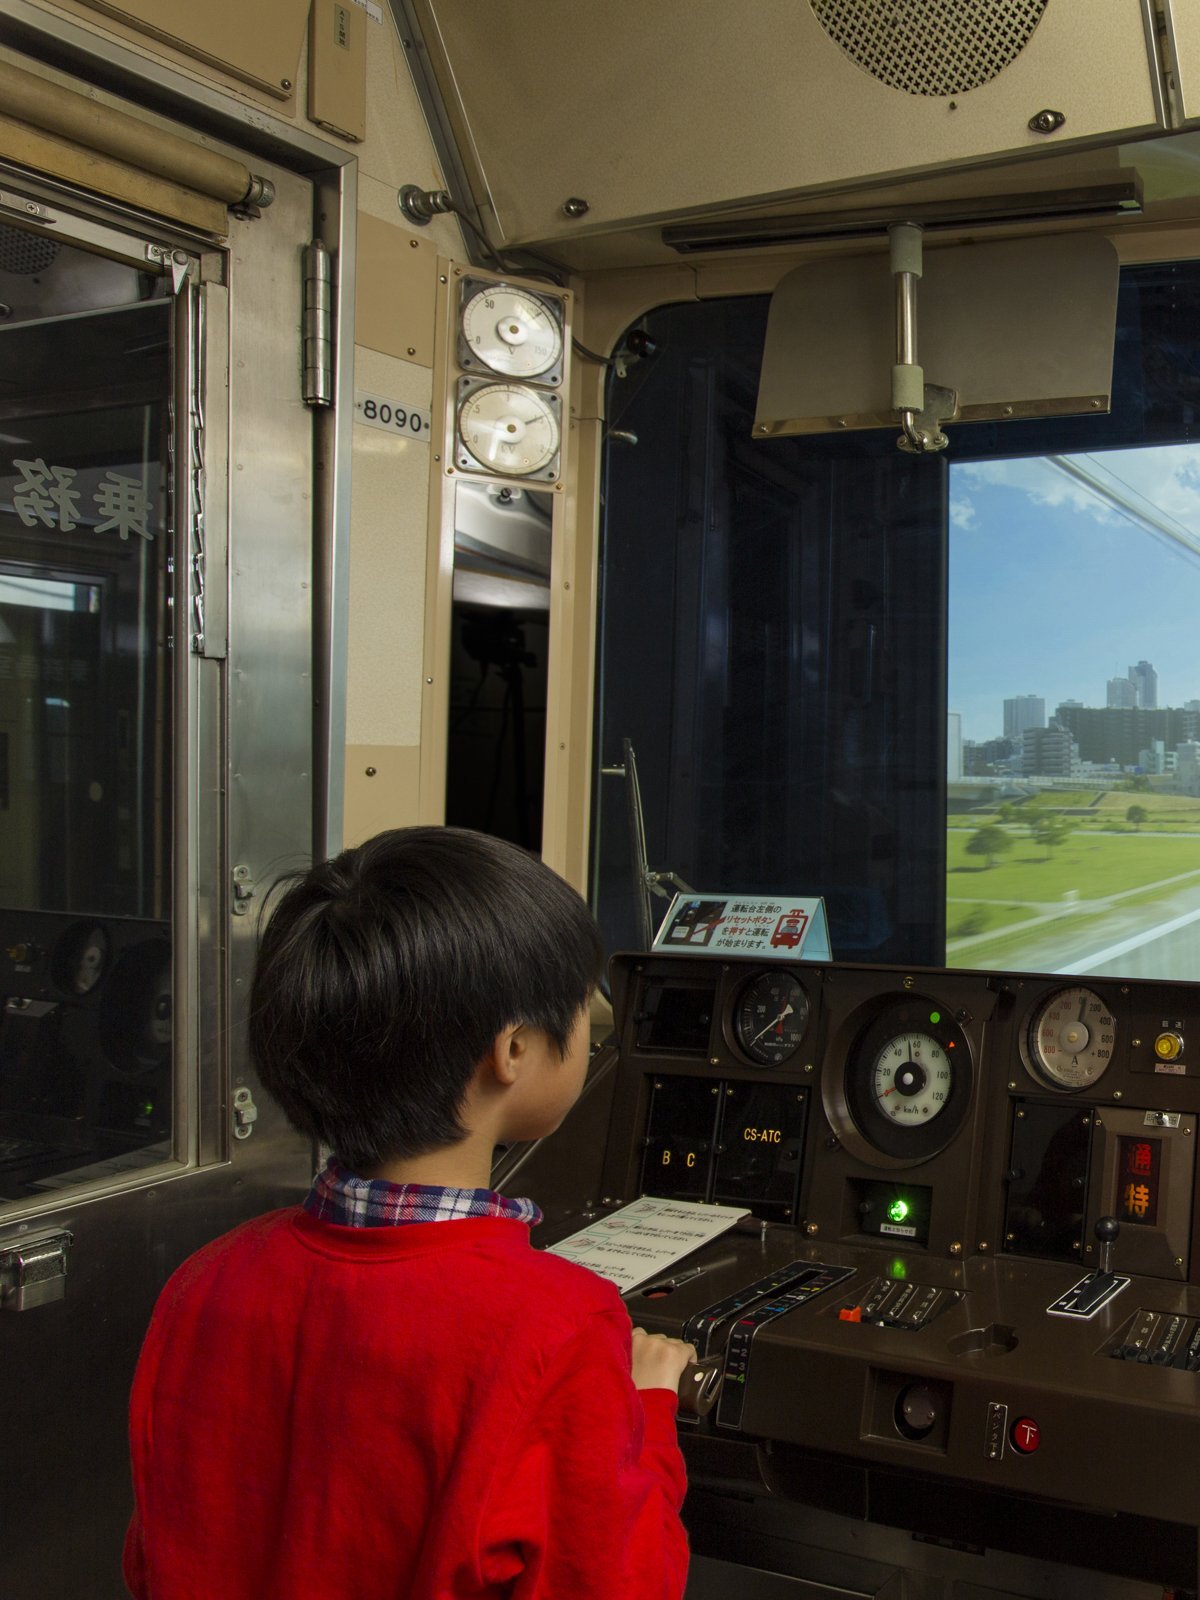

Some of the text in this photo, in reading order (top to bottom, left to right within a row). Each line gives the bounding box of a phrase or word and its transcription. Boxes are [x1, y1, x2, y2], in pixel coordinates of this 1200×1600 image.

[485, 298, 495, 310] 50
[475, 336, 481, 345] 0
[364, 399, 422, 433] 8090
[730, 903, 782, 914] 運転台左側の
[724, 915, 775, 925] リセットボタン
[721, 926, 770, 937] を押すと運転
[912, 1040, 921, 1049] 60
[894, 1048, 902, 1057] 40
[931, 1049, 940, 1058] 80
[1071, 1055, 1079, 1066] A
[882, 1068, 891, 1077] 20
[937, 1070, 949, 1080] 100
[932, 1091, 943, 1101] 120
[903, 1104, 919, 1115] km/h
[743, 1127, 782, 1144] CS-ATC
[662, 1150, 695, 1168] B C
[741, 1348, 748, 1357] 2
[739, 1362, 746, 1371] 3
[737, 1373, 745, 1384] 4
[1021, 1424, 1038, 1445] 下
